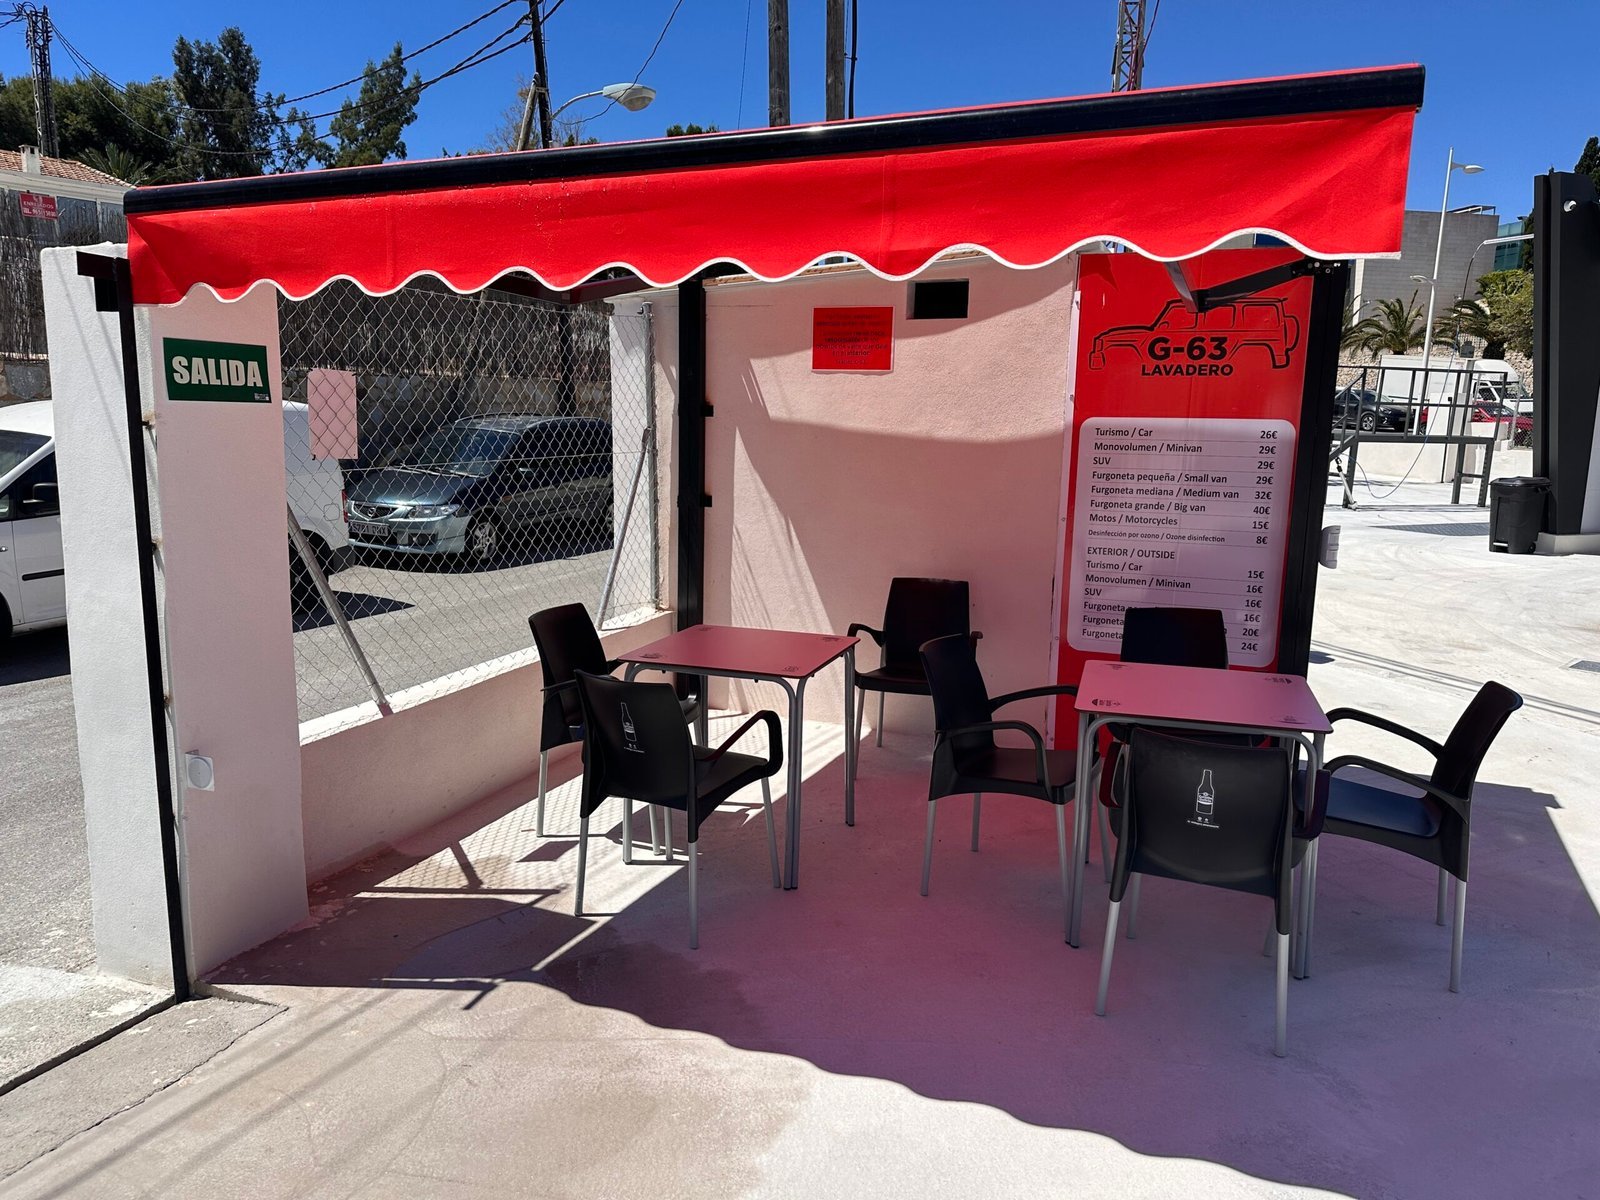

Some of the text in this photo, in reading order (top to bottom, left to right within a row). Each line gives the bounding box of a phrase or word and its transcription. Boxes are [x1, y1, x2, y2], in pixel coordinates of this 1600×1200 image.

[1148, 336, 1228, 361] G-63
[172, 356, 263, 387] SALIDA
[1141, 364, 1233, 376] LAVADERO
[1095, 428, 1129, 437] Turismo
[1138, 429, 1153, 437] Car
[1260, 431, 1278, 440] 26€
[1094, 443, 1157, 452] Monovolumen
[1166, 444, 1202, 453] Minivan
[1259, 446, 1276, 455] 29€
[1093, 457, 1275, 470] SUV 29€
[1092, 472, 1135, 482] Furgoneta
[1137, 472, 1175, 482] pequeña
[1184, 474, 1209, 483] Small
[1256, 476, 1274, 485] 29€
[1091, 486, 1134, 496] Furgoneta
[1136, 487, 1174, 496] mediana
[1183, 488, 1220, 498] Medium
[1254, 491, 1272, 500] 32€
[1090, 500, 1133, 510] Furgoneta
[1135, 501, 1165, 511] grande
[1174, 503, 1188, 513] Big
[1190, 504, 1206, 512] van
[1253, 506, 1271, 515] 40€
[1089, 514, 1116, 523] Motos
[1125, 515, 1178, 526] Motorcycles
[1252, 521, 1269, 530] 15€
[1088, 529, 1127, 538] Desinfección
[1188, 534, 1225, 543] disinfection
[1256, 536, 1268, 544] 8€
[1087, 547, 1128, 557] EXTERIOR
[1137, 550, 1175, 559] OUTSIDE
[1087, 560, 1120, 570] Turismo
[1128, 562, 1142, 571] Car
[1248, 570, 1265, 579] 15€
[1085, 574, 1147, 586] Monovolumen
[1156, 579, 1191, 589] Minivan
[1246, 585, 1263, 593] 16€
[1085, 588, 1262, 608] SUV 16€
[1084, 602, 1125, 612] Furgoneta
[1244, 614, 1261, 622] 16€
[1083, 615, 1124, 626] Furgoneta
[1082, 628, 1258, 651] Furgoneta 24€
